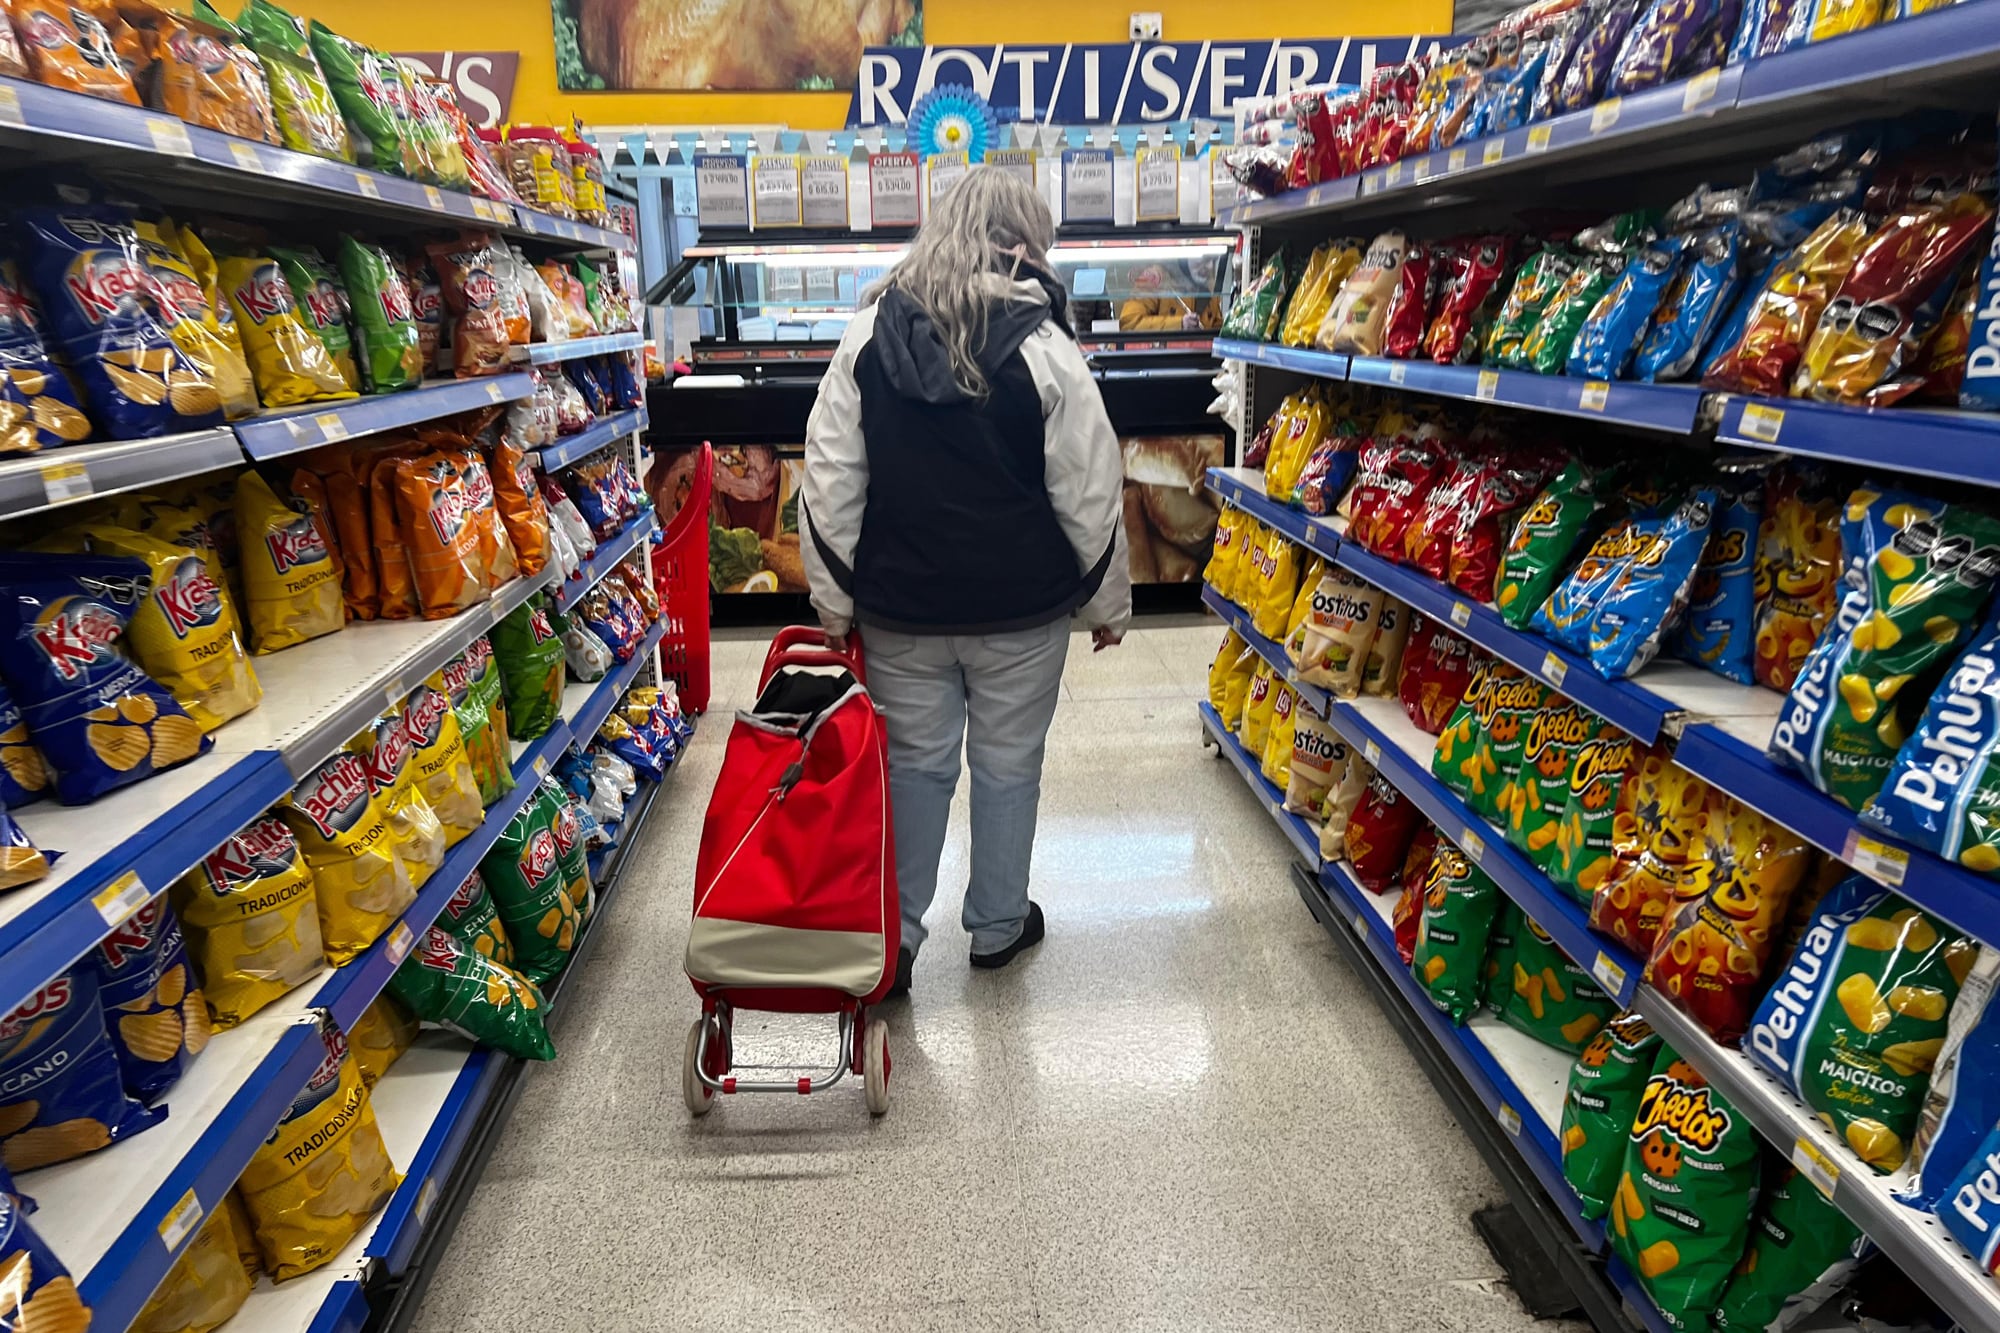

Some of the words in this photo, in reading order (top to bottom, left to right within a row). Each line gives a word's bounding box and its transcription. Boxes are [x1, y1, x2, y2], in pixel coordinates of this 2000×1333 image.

[873, 155, 913, 167] OFERTA
[1819, 1059, 1906, 1098] MAICITOS
[1631, 1078, 1728, 1150] Cheetos
[1642, 1172, 1683, 1194] ORIGINAL
